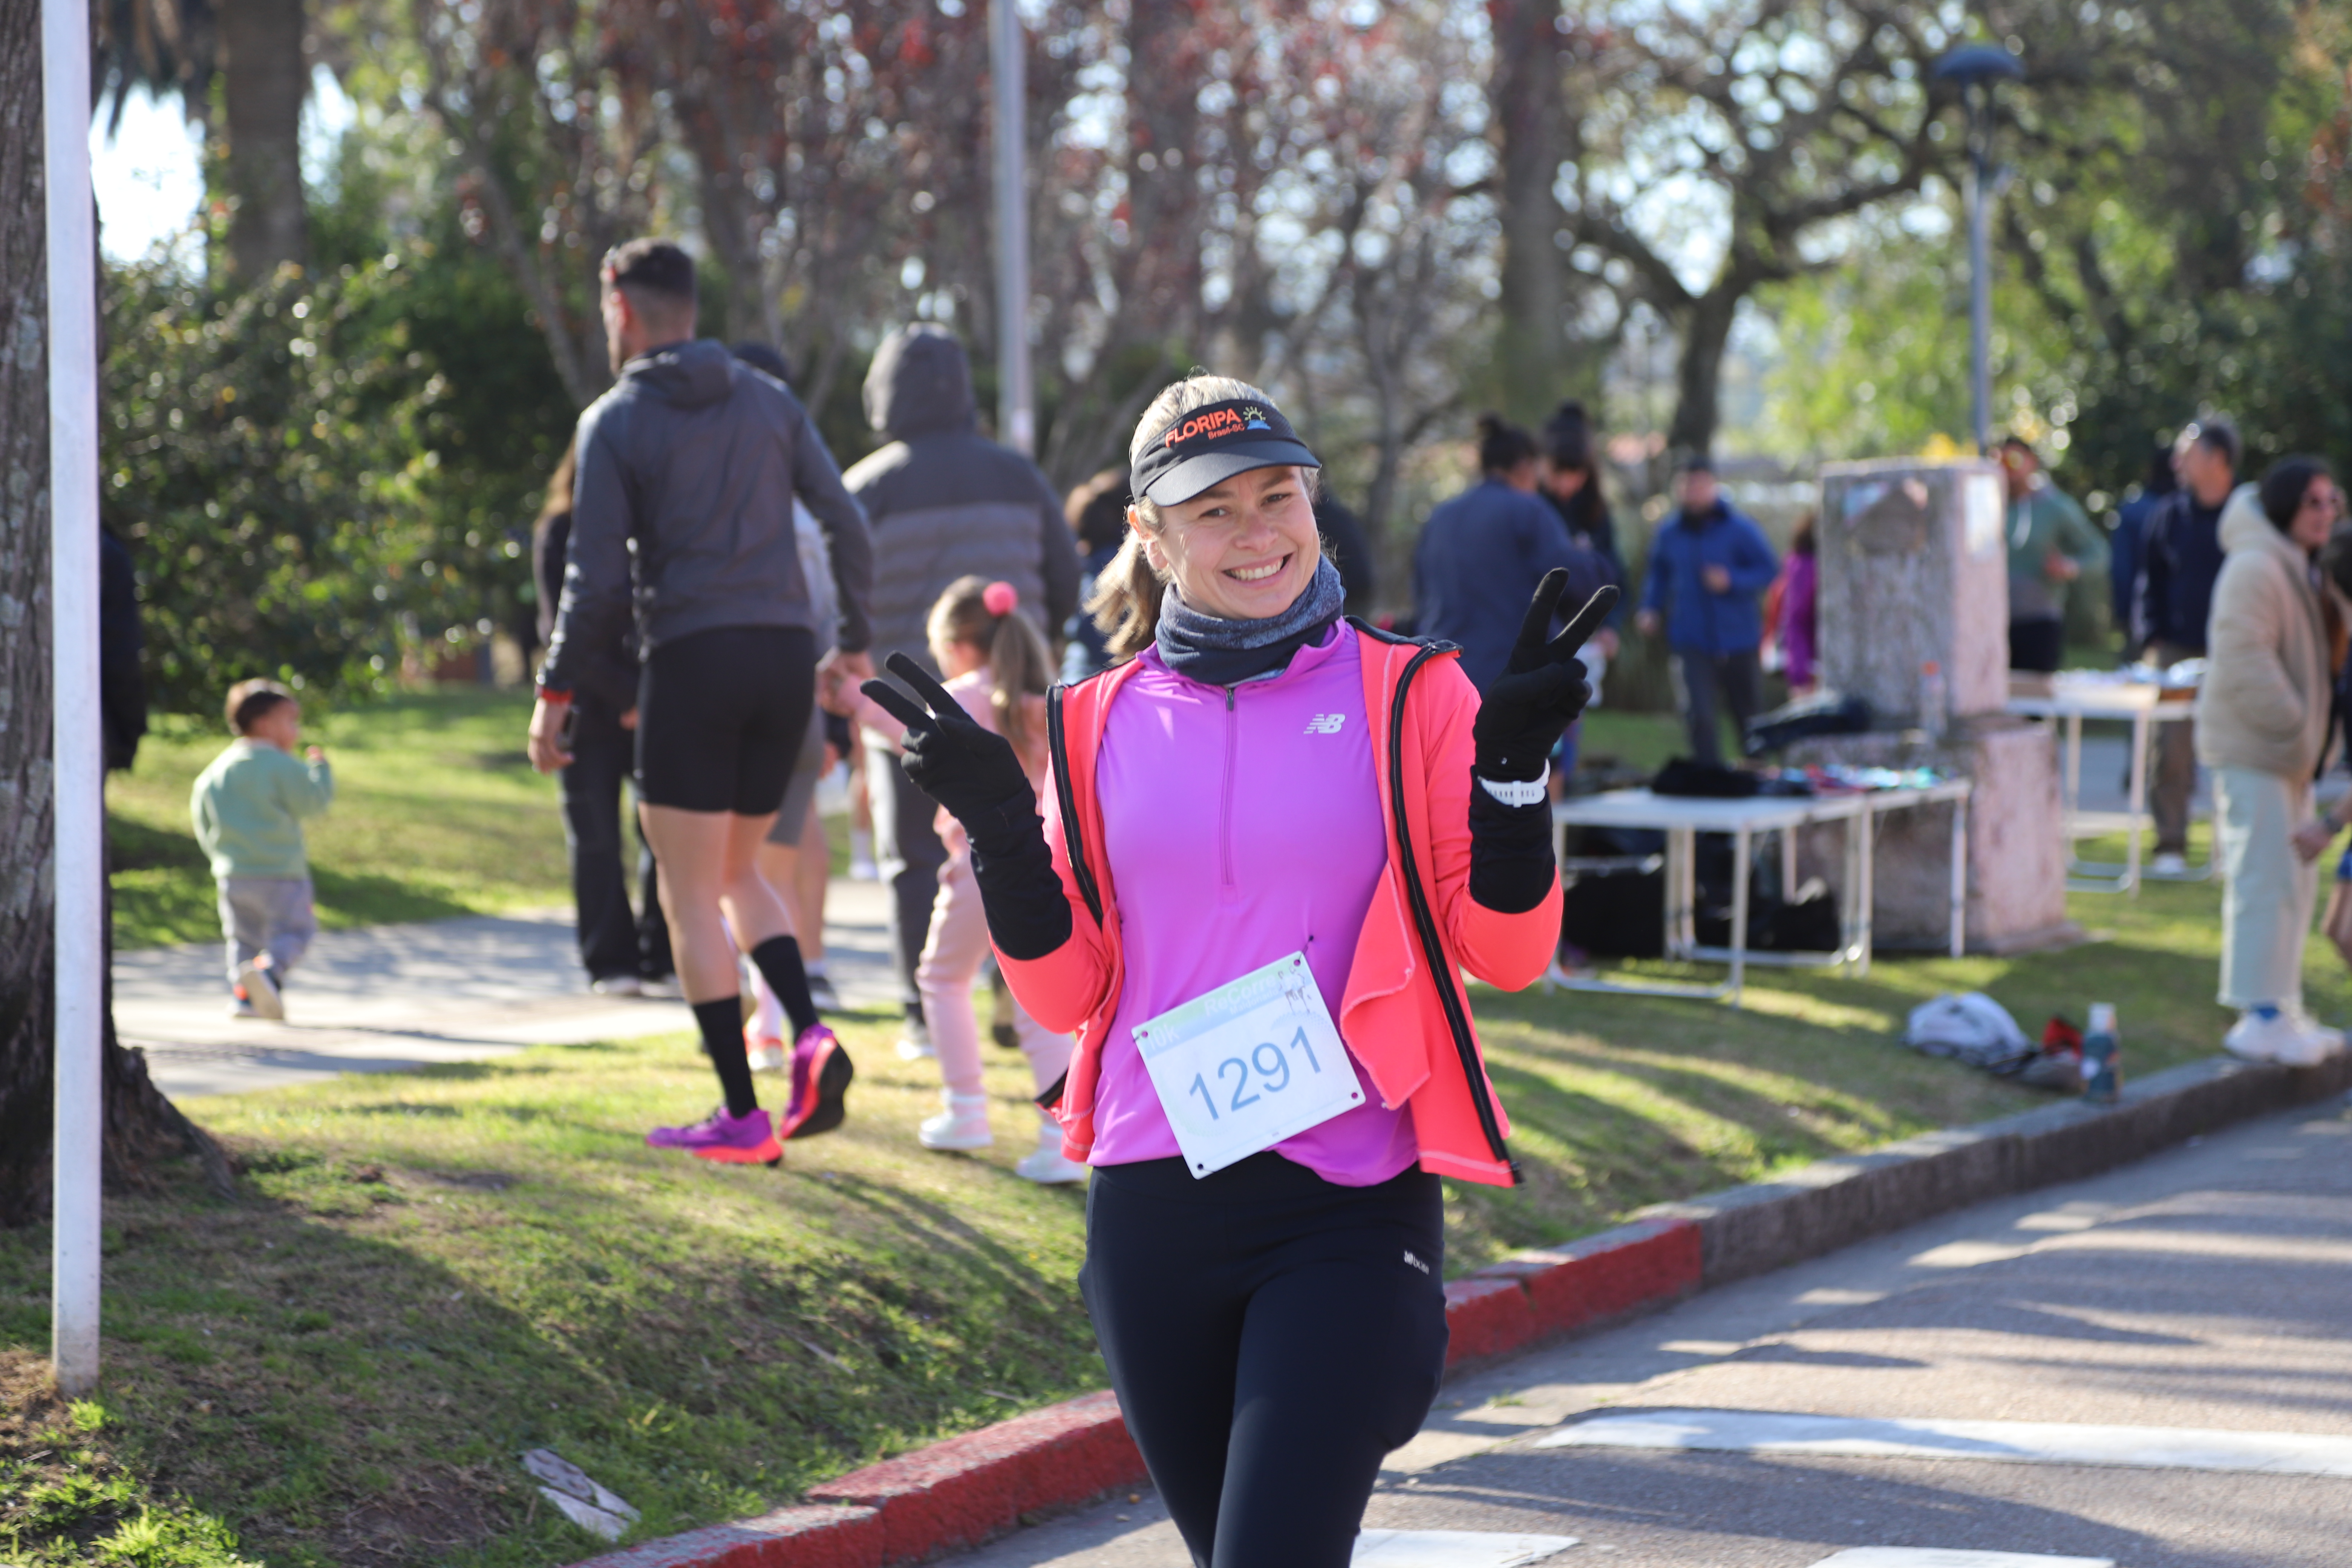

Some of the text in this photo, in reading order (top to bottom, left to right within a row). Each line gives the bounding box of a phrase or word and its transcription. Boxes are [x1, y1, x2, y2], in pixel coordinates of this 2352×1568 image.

[1165, 408, 1242, 448] FLORIPA
[1205, 974, 1276, 1018] ReCorre
[1147, 1022, 1180, 1052] 10k
[1189, 1025, 1321, 1121] 1291
